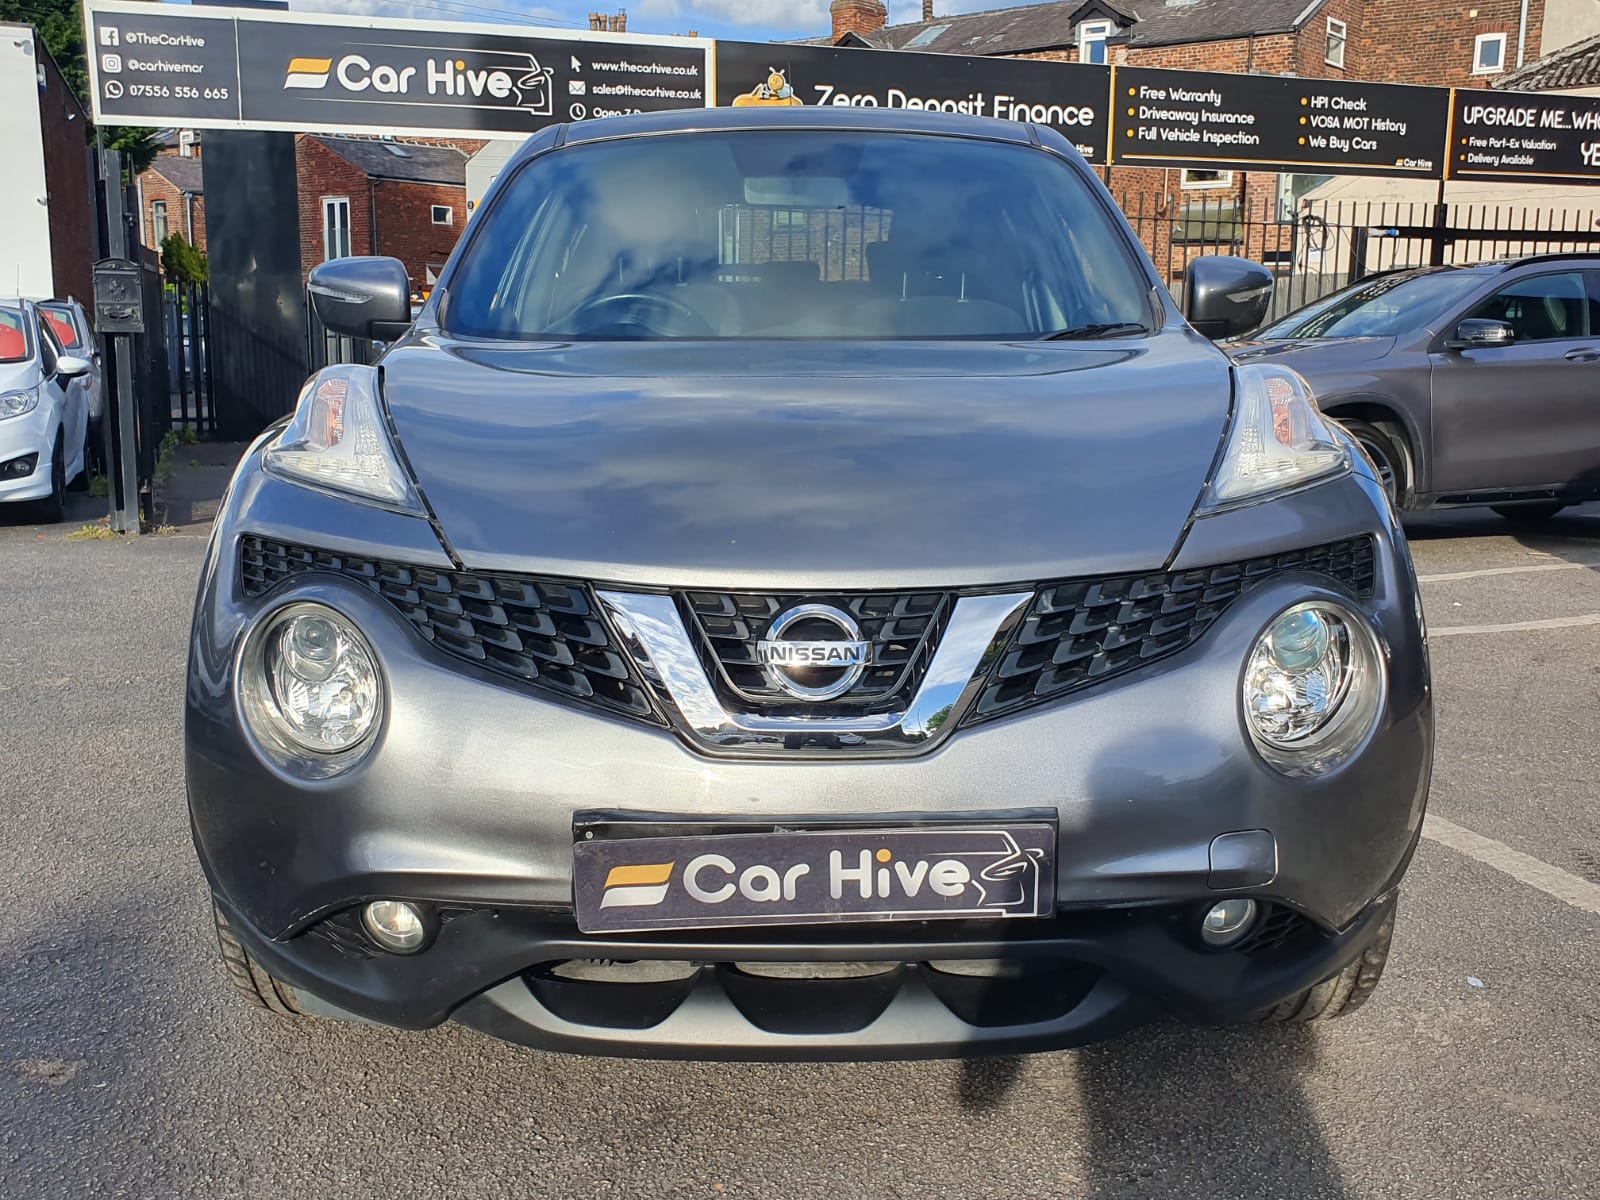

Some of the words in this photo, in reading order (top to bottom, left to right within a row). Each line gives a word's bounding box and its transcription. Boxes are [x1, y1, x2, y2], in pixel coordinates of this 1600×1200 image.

[125, 32, 205, 47] @TheCarHive
[127, 59, 204, 73] @carhivemcr
[591, 61, 698, 76] www.thecarhive.co.uk
[336, 54, 417, 94] Car
[426, 58, 513, 98] Hive
[129, 84, 170, 98] 07556
[174, 86, 199, 99] 556
[203, 87, 229, 100] 665
[592, 83, 702, 100] sales@thecarhive.co.uk
[1139, 85, 1167, 100] Free
[1168, 87, 1222, 107] Warranty
[992, 95, 1095, 127] Finance
[1310, 95, 1329, 109] HPI
[1330, 96, 1367, 111] Check
[1139, 105, 1199, 126] Driveaway
[1201, 109, 1255, 125] Insurance
[1463, 105, 1537, 128] UPGRADE
[1310, 114, 1341, 129] VOSA
[1342, 116, 1370, 130] MOT
[1371, 118, 1407, 136] History
[1138, 126, 1158, 140] Full
[1159, 127, 1201, 142] Vehicle
[1202, 129, 1260, 147] Inspection
[1308, 134, 1327, 148] We
[1329, 135, 1350, 153] Buy
[1351, 136, 1377, 150] Cars
[1468, 136, 1488, 148] Free
[1521, 138, 1557, 150] Valuation
[1467, 152, 1500, 167] Delivery
[769, 645, 861, 662] NISSAN
[683, 853, 810, 904] Car
[829, 848, 971, 900] Hive
